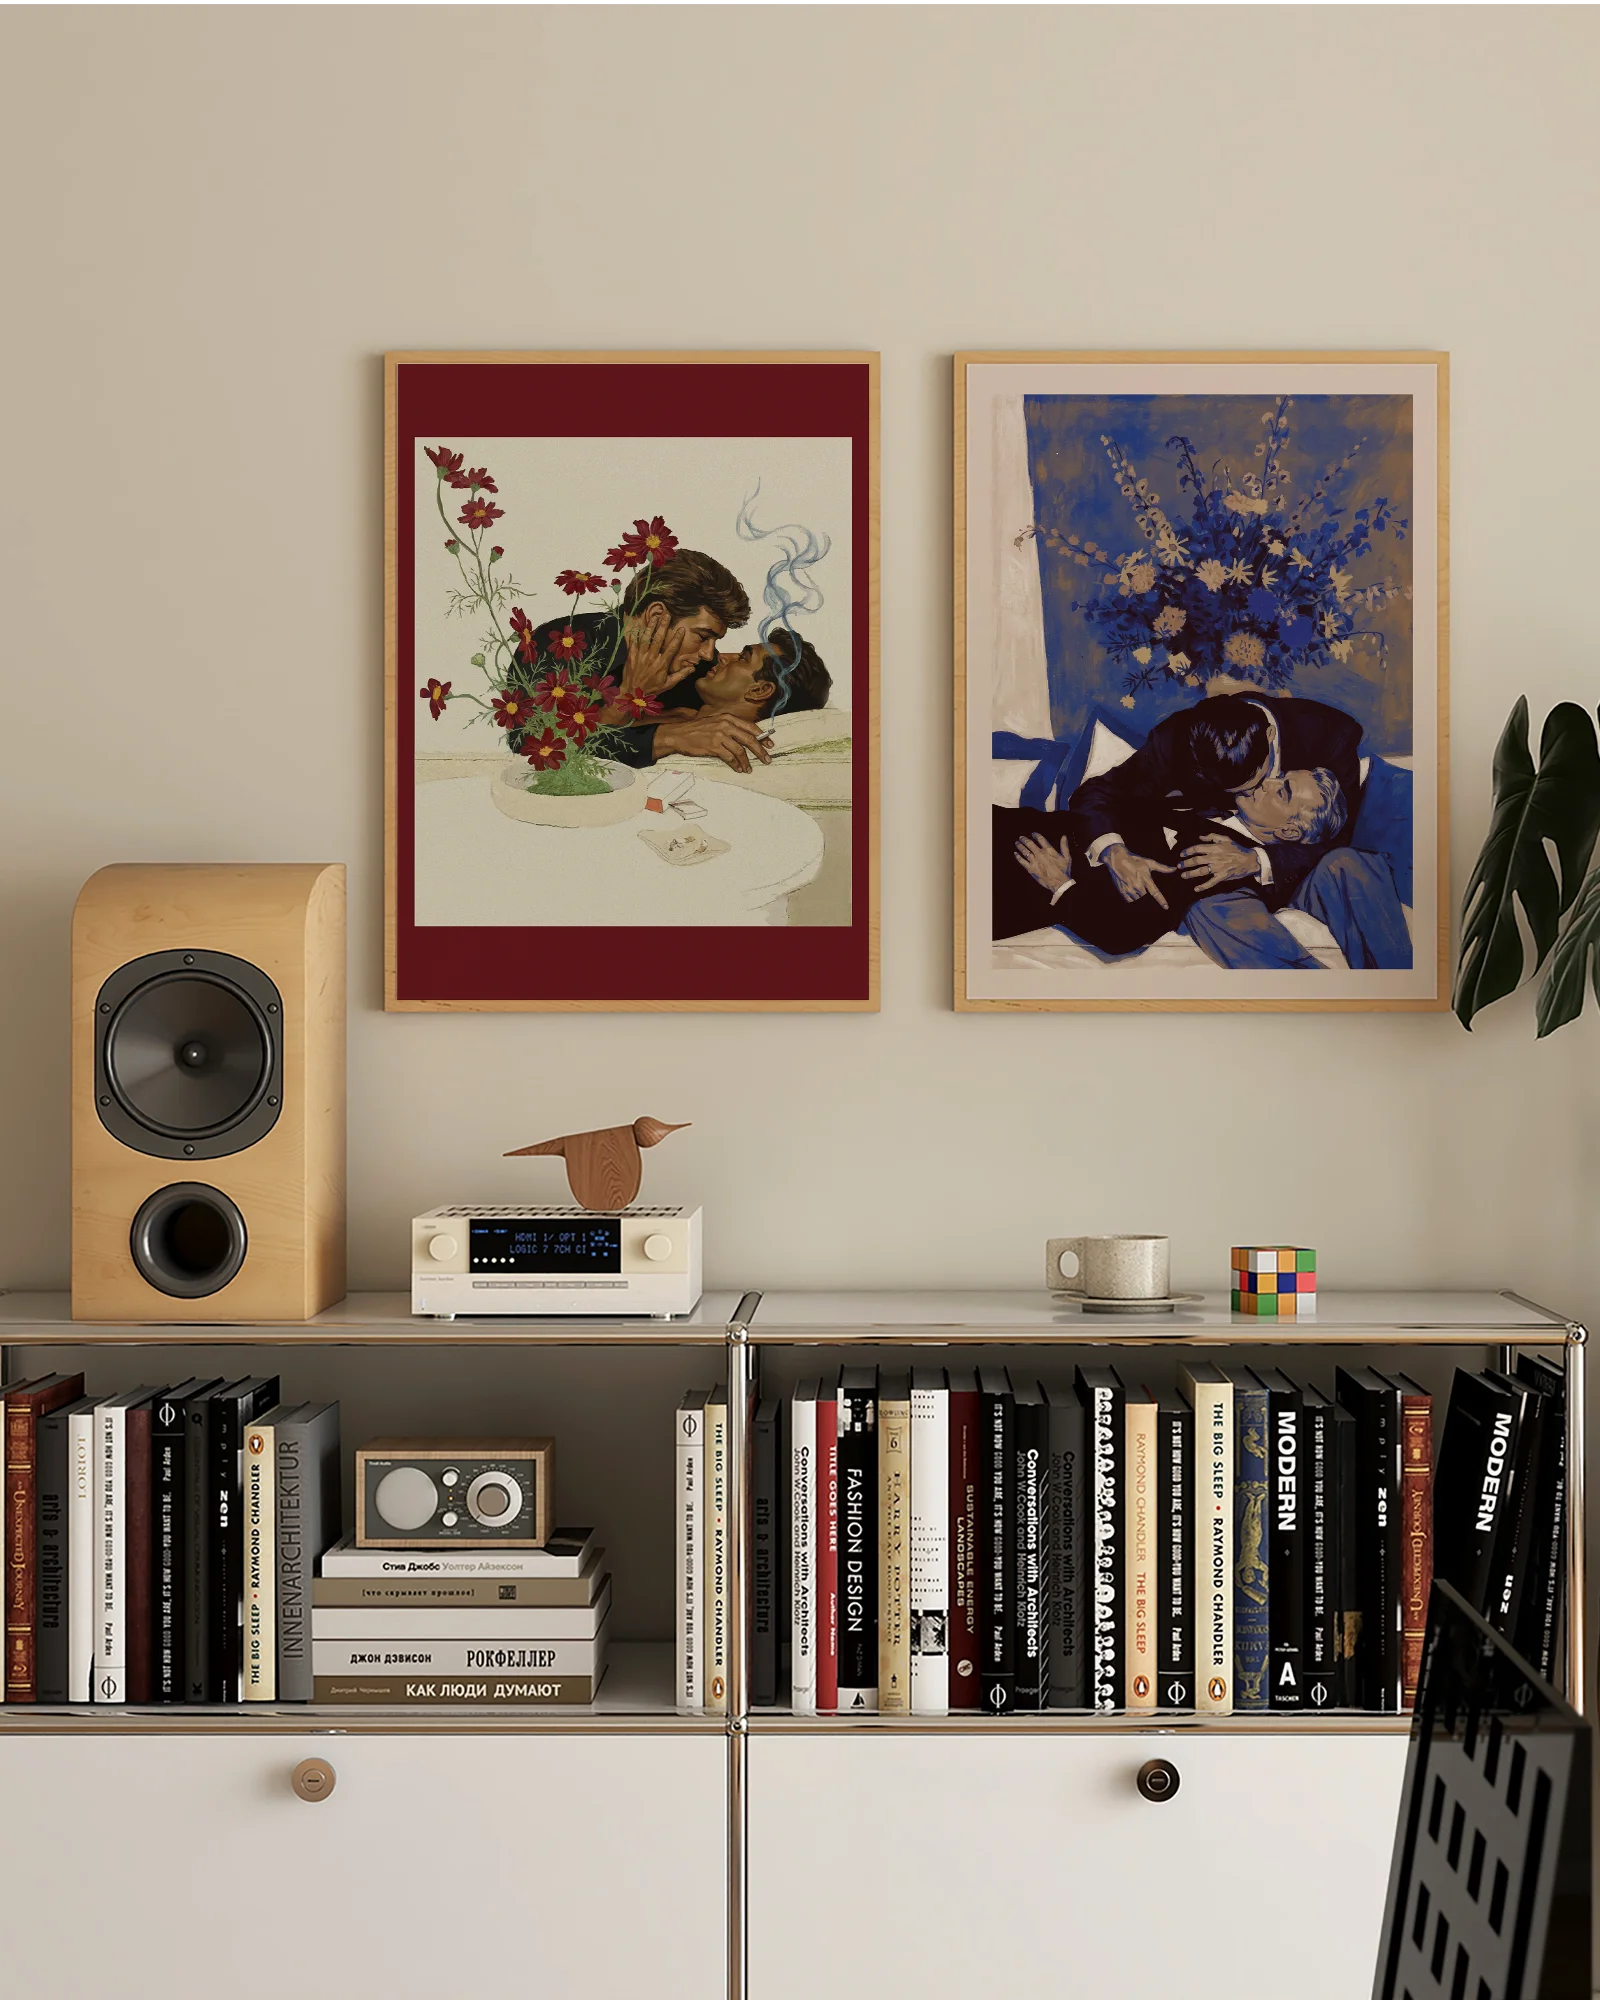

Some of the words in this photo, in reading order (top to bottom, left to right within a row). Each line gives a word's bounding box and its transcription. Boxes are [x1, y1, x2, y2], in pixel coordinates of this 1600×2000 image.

[515, 1233, 537, 1242] HDMI
[543, 1233, 554, 1242] 1/
[559, 1233, 575, 1242] OPT
[582, 1233, 586, 1242] 1
[715, 1424, 723, 1444] THE
[1213, 1403, 1223, 1426] THE
[715, 1451, 723, 1471] BIG
[793, 1448, 802, 1475] John
[829, 1446, 837, 1476] TITLE
[1137, 1433, 1146, 1494] RAYMOND
[1213, 1433, 1223, 1455] BIG
[78, 1435, 86, 1499] LORIOT
[1017, 1450, 1027, 1478] John
[1052, 1452, 1062, 1478] John
[1213, 1462, 1223, 1498] SLEEP
[1278, 1412, 1297, 1530] MODERN
[1475, 1412, 1512, 1532] MODERN
[43, 1494, 60, 1521] arts
[220, 1491, 228, 1527] zen
[251, 1464, 261, 1524] CHANDLER
[715, 1478, 723, 1511] SLEEP
[757, 1498, 771, 1525] arts
[793, 1480, 802, 1522] W.Cook
[800, 1446, 809, 1547] Conversations
[829, 1480, 837, 1516] GOES
[847, 1469, 863, 1552] FASHION
[1017, 1481, 1027, 1524] W.Cook
[1027, 1449, 1039, 1549] Conversations
[1052, 1482, 1062, 1524] W.Cook
[1063, 1451, 1075, 1551] Conversations
[1378, 1488, 1387, 1527] zen
[12, 1490, 26, 1560] UNEXPECTED
[893, 1471, 901, 1558] HARRY
[966, 1485, 974, 1576] SUSTAINABLE
[1137, 1497, 1146, 1562] CHANDLER
[1411, 1489, 1426, 1539] JOURNEY
[279, 1441, 304, 1659] INNENARCHITEKTUR
[793, 1528, 802, 1546] and
[829, 1521, 837, 1552] HERE
[1017, 1528, 1027, 1549] and
[1052, 1528, 1062, 1550] and
[1213, 1518, 1223, 1588] RAYMOND
[251, 1529, 261, 1589] RAYMOND
[382, 1563, 406, 1571] Стив
[408, 1563, 440, 1572] Джобс
[442, 1563, 476, 1572] Уолтер
[478, 1562, 523, 1571] Айзексон
[715, 1530, 723, 1594] RAYMOND
[793, 1551, 802, 1596] Heinrich
[800, 1552, 809, 1580] with
[956, 1517, 965, 1606] LANDSCAPES
[1017, 1553, 1027, 1597] Heinrich
[1027, 1554, 1039, 1582] with
[1052, 1554, 1062, 1597] Heinrich
[1063, 1554, 1075, 1582] with
[1411, 1539, 1424, 1610] UNEXPECTED
[10, 1560, 26, 1611] JOURNEY
[43, 1545, 63, 1628] architecture
[757, 1549, 772, 1633] architecture
[847, 1561, 863, 1631] DESIGN
[1137, 1573, 1146, 1595] THE
[1500, 1575, 1514, 1614] zen
[251, 1604, 261, 1635] SLEEP
[793, 1600, 802, 1625] Klotz
[800, 1585, 809, 1656] Architects
[893, 1565, 901, 1646] POTTER
[966, 1581, 974, 1633] ENERGY
[1017, 1601, 1027, 1627] Klotz
[1027, 1587, 1039, 1657] Architects
[1052, 1601, 1062, 1627] Klotz
[1063, 1587, 1075, 1656] Architects
[1137, 1599, 1146, 1618] BIG
[105, 1623, 113, 1636] Paul
[715, 1600, 723, 1665] CHANDLER
[1137, 1622, 1146, 1654] SLEEP
[1172, 1628, 1182, 1641] Paul
[1213, 1594, 1223, 1665] CHANDLER
[1315, 1627, 1323, 1641] Paul
[251, 1640, 261, 1659] BIG
[350, 1653, 381, 1665] ДЖОН
[384, 1653, 432, 1664] ДЭВИСОН
[467, 1650, 556, 1668] РОКФЕЛЛЕР
[251, 1665, 261, 1684] THE
[406, 1684, 436, 1697] КАК
[440, 1684, 487, 1699] ЛЮДИ
[493, 1684, 561, 1699] ДУМАЮТ
[1279, 1661, 1296, 1686] A
